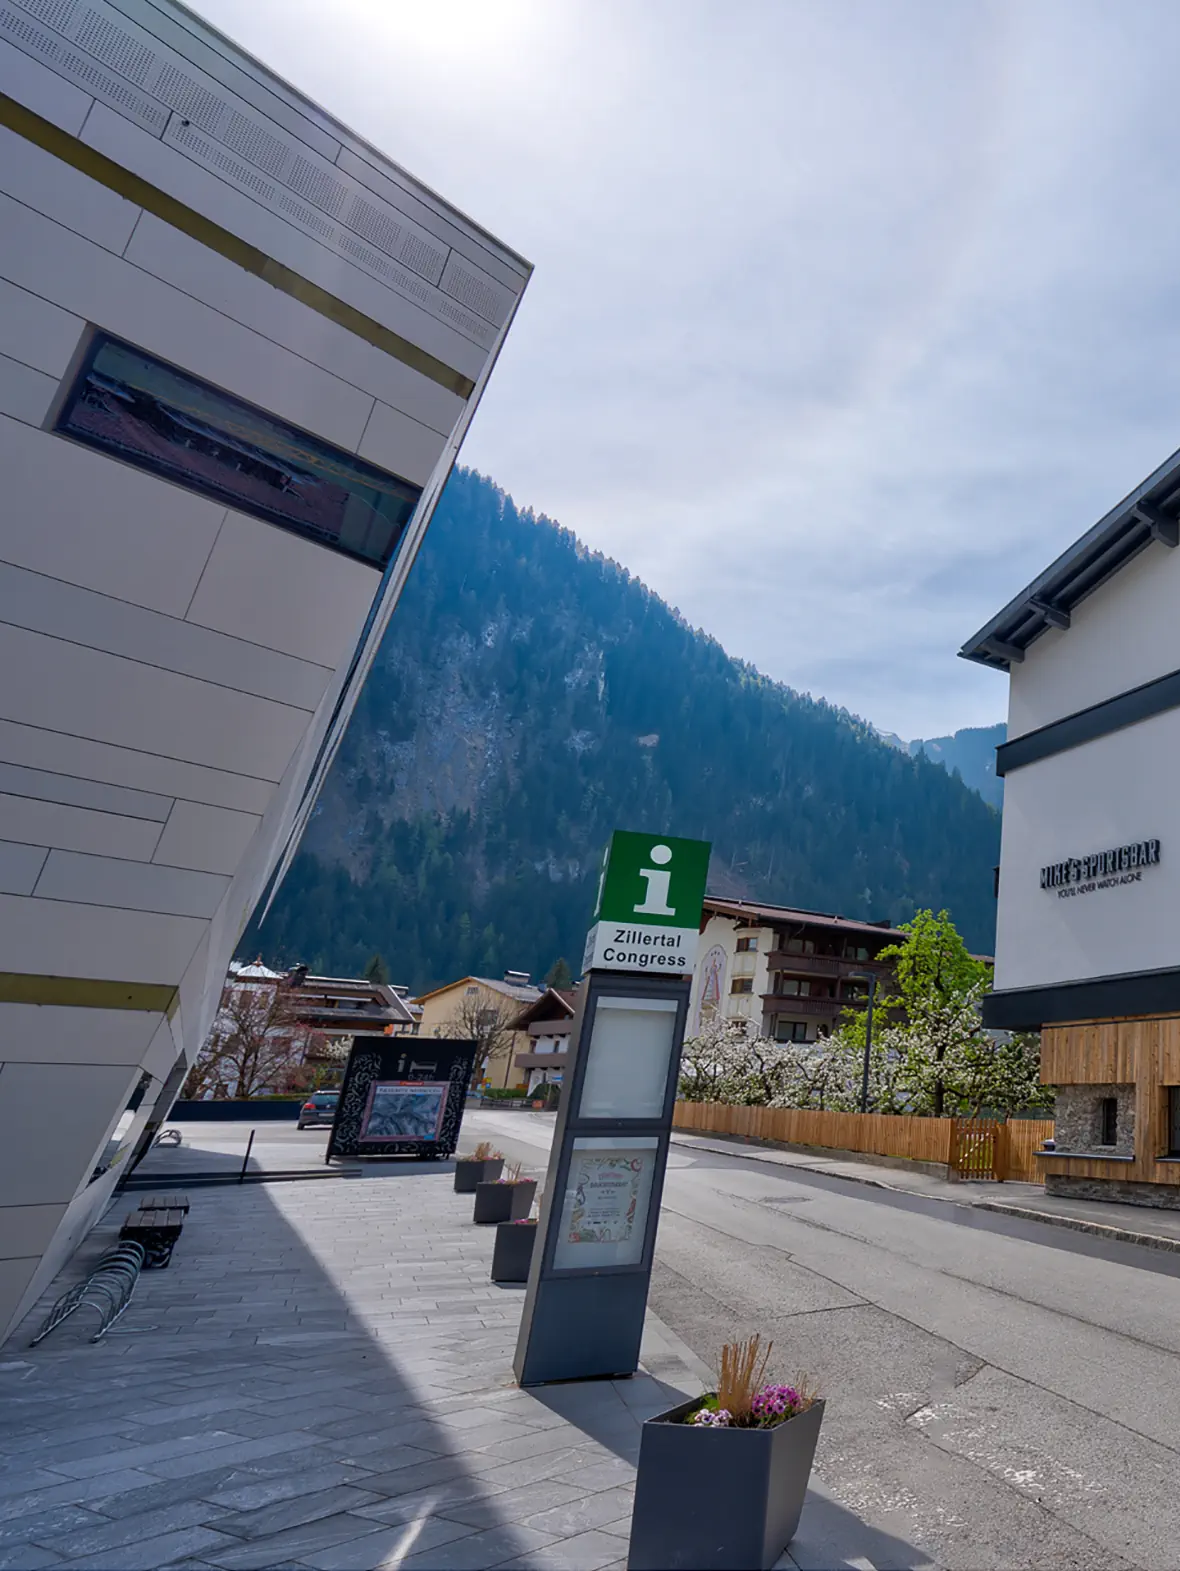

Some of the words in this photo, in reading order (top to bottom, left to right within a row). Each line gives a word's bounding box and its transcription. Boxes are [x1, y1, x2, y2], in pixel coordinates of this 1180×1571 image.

[1082, 839, 1161, 881] SPORTSBAR
[1077, 881, 1097, 895] NEVER
[1097, 876, 1120, 890] WATCH
[1119, 871, 1142, 885] ALONE
[614, 929, 681, 948] Zillertal
[603, 948, 686, 967] Congress
